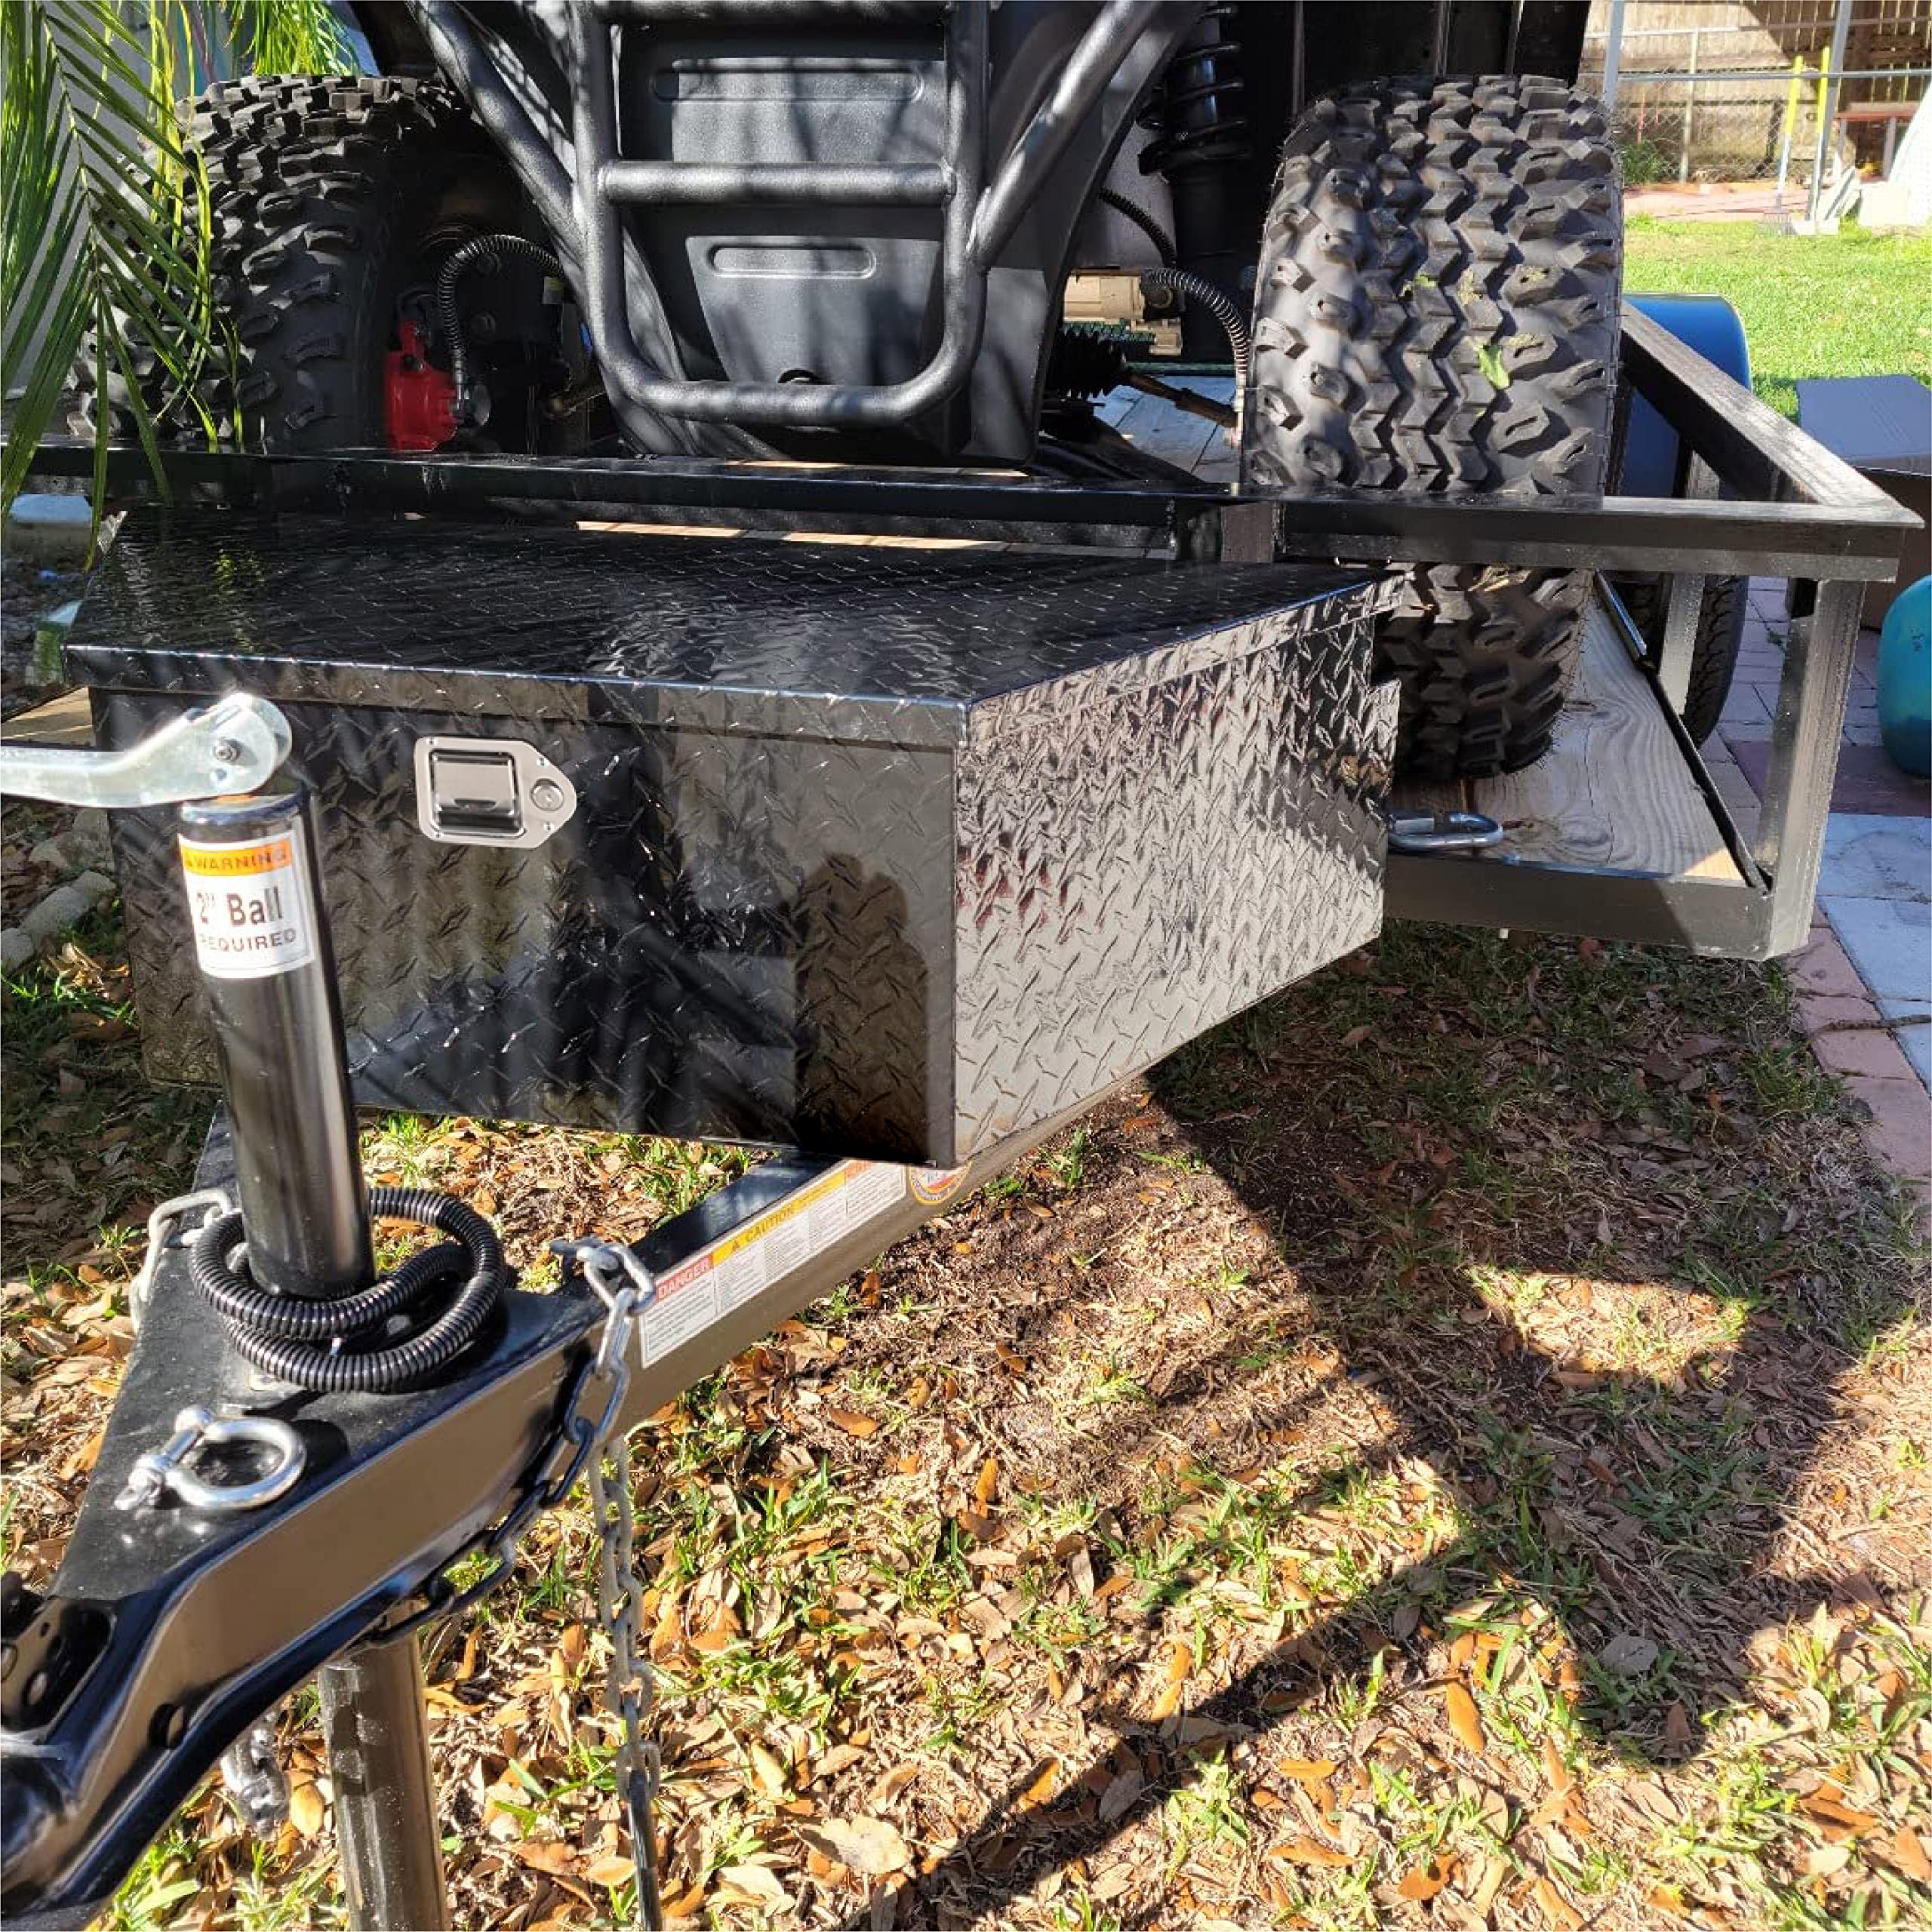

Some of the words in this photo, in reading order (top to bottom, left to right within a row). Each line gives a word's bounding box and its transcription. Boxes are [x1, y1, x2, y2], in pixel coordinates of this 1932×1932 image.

[193, 848, 288, 870] WARNING
[226, 885, 283, 927] Ball
[198, 928, 297, 952] REQUIRED
[657, 1254, 712, 1300] DANGER
